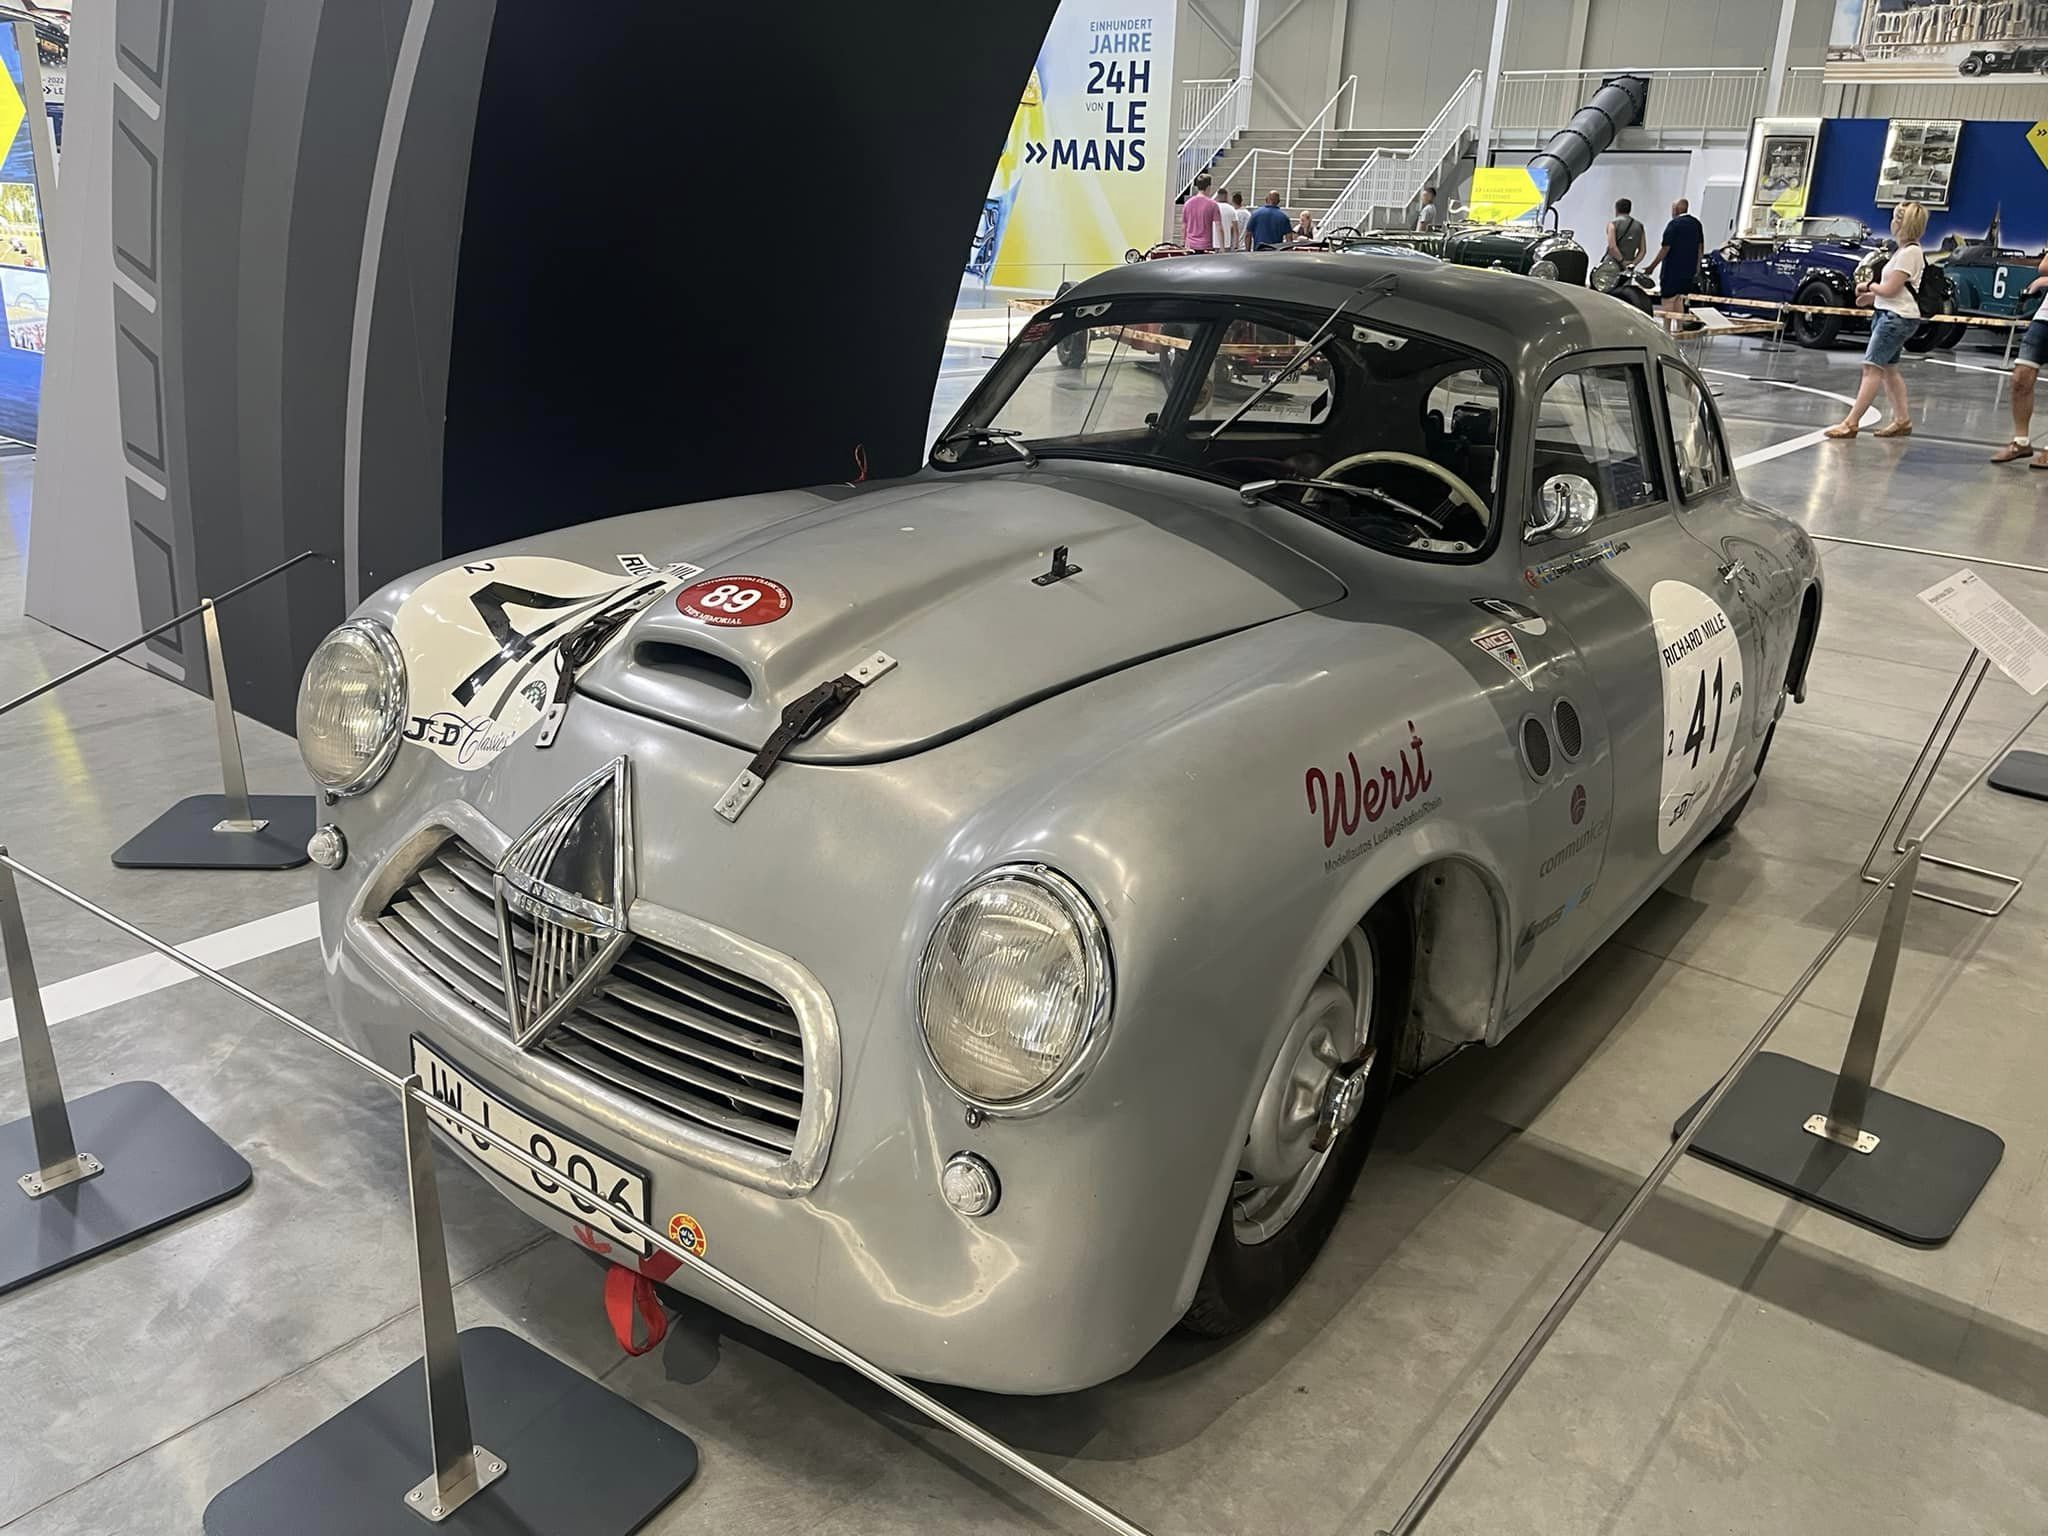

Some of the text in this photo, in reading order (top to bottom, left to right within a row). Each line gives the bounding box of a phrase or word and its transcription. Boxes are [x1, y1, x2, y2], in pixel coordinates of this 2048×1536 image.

[1090, 19, 1152, 32] EINHUNDERT
[1089, 33, 1152, 54] JAHRE
[1087, 60, 1150, 94] 24H
[1086, 101, 1147, 133] VON LE
[1051, 139, 1146, 172] MANS
[1993, 266, 2008, 299] 6
[464, 563, 495, 574] 2
[700, 584, 762, 613] 89
[1662, 612, 1727, 668] RICHARD MILLE
[1683, 656, 1723, 770] 41
[1667, 729, 1674, 757] 2
[1305, 719, 1433, 849] Werst
[1324, 838, 1373, 875] Modellautos
[529, 1133, 636, 1235] 806
